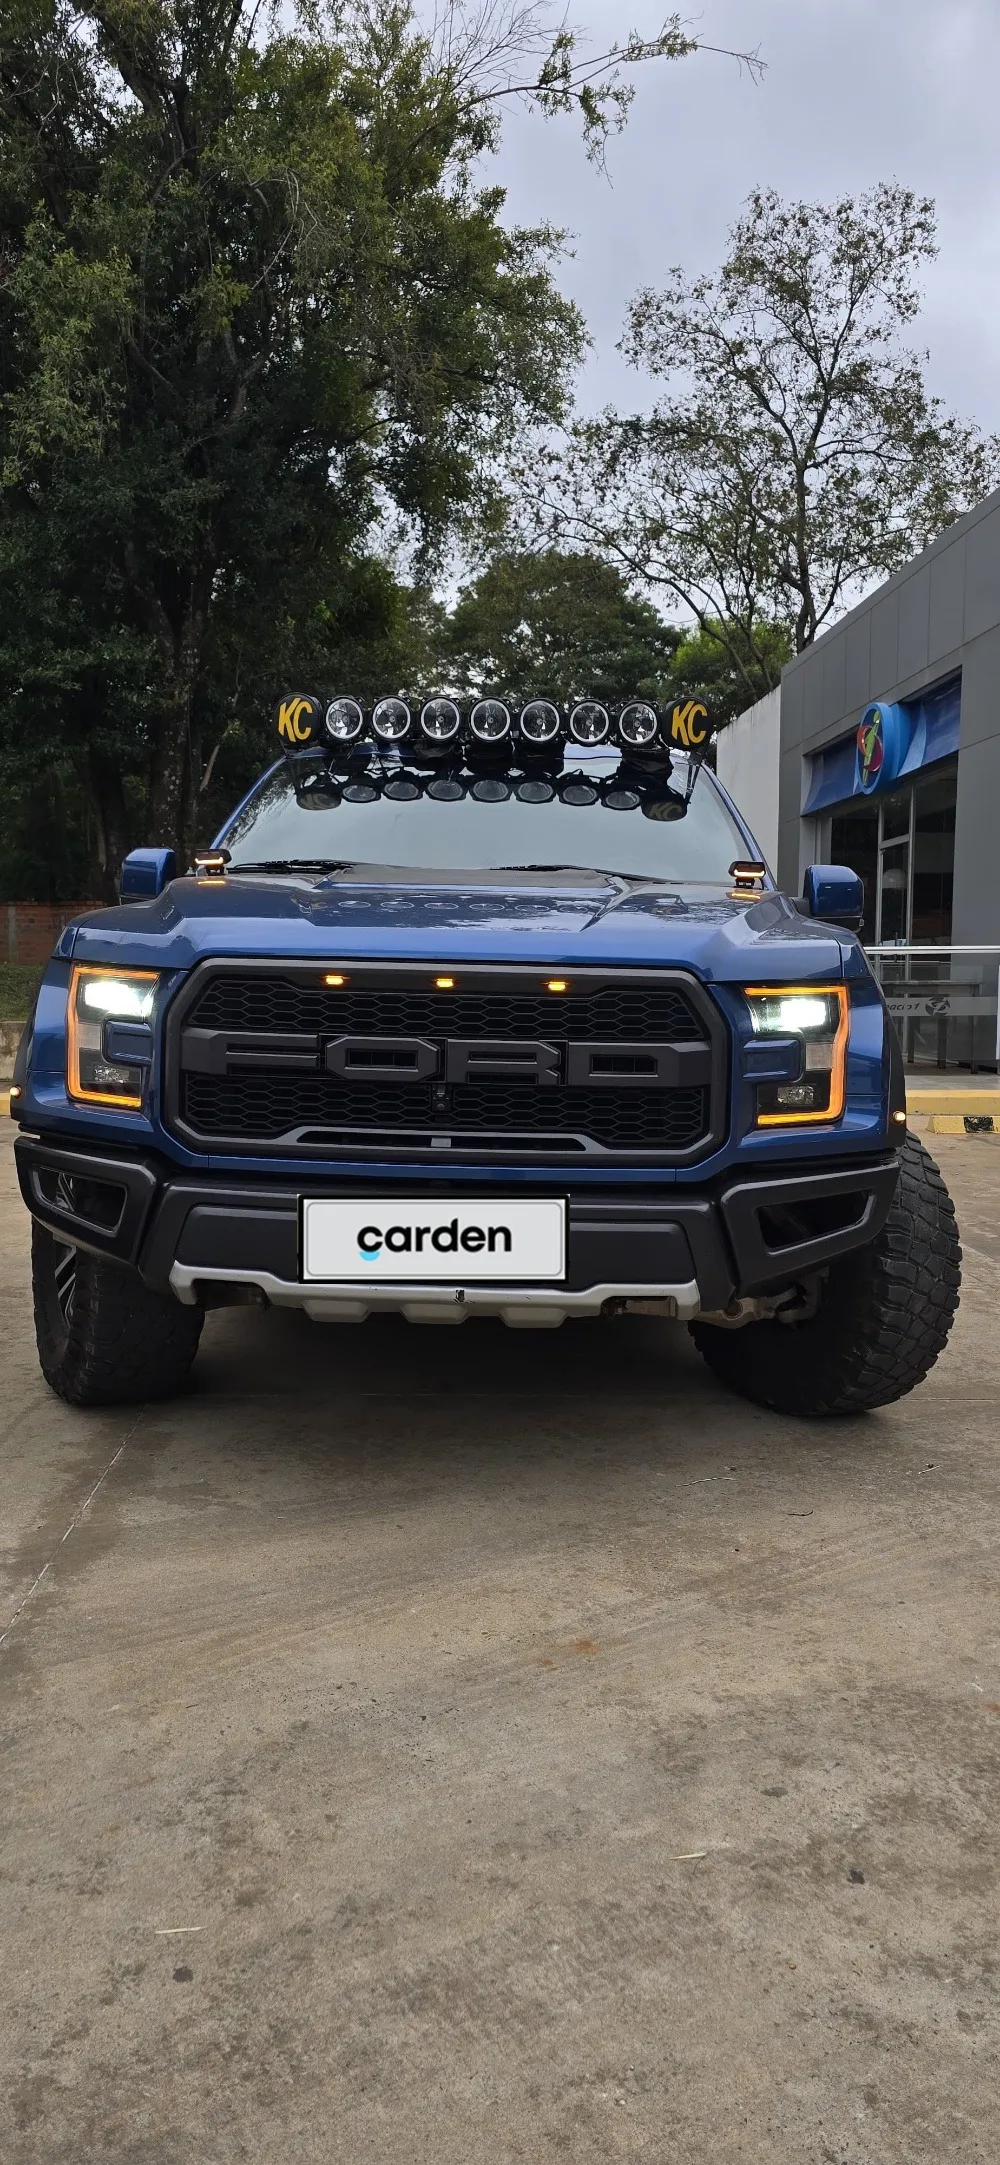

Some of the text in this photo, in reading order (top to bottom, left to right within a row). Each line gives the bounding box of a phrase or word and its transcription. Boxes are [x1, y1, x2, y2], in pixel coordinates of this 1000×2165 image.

[278, 697, 313, 743] KC
[671, 700, 708, 746] KC
[180, 1027, 711, 1087] FORD
